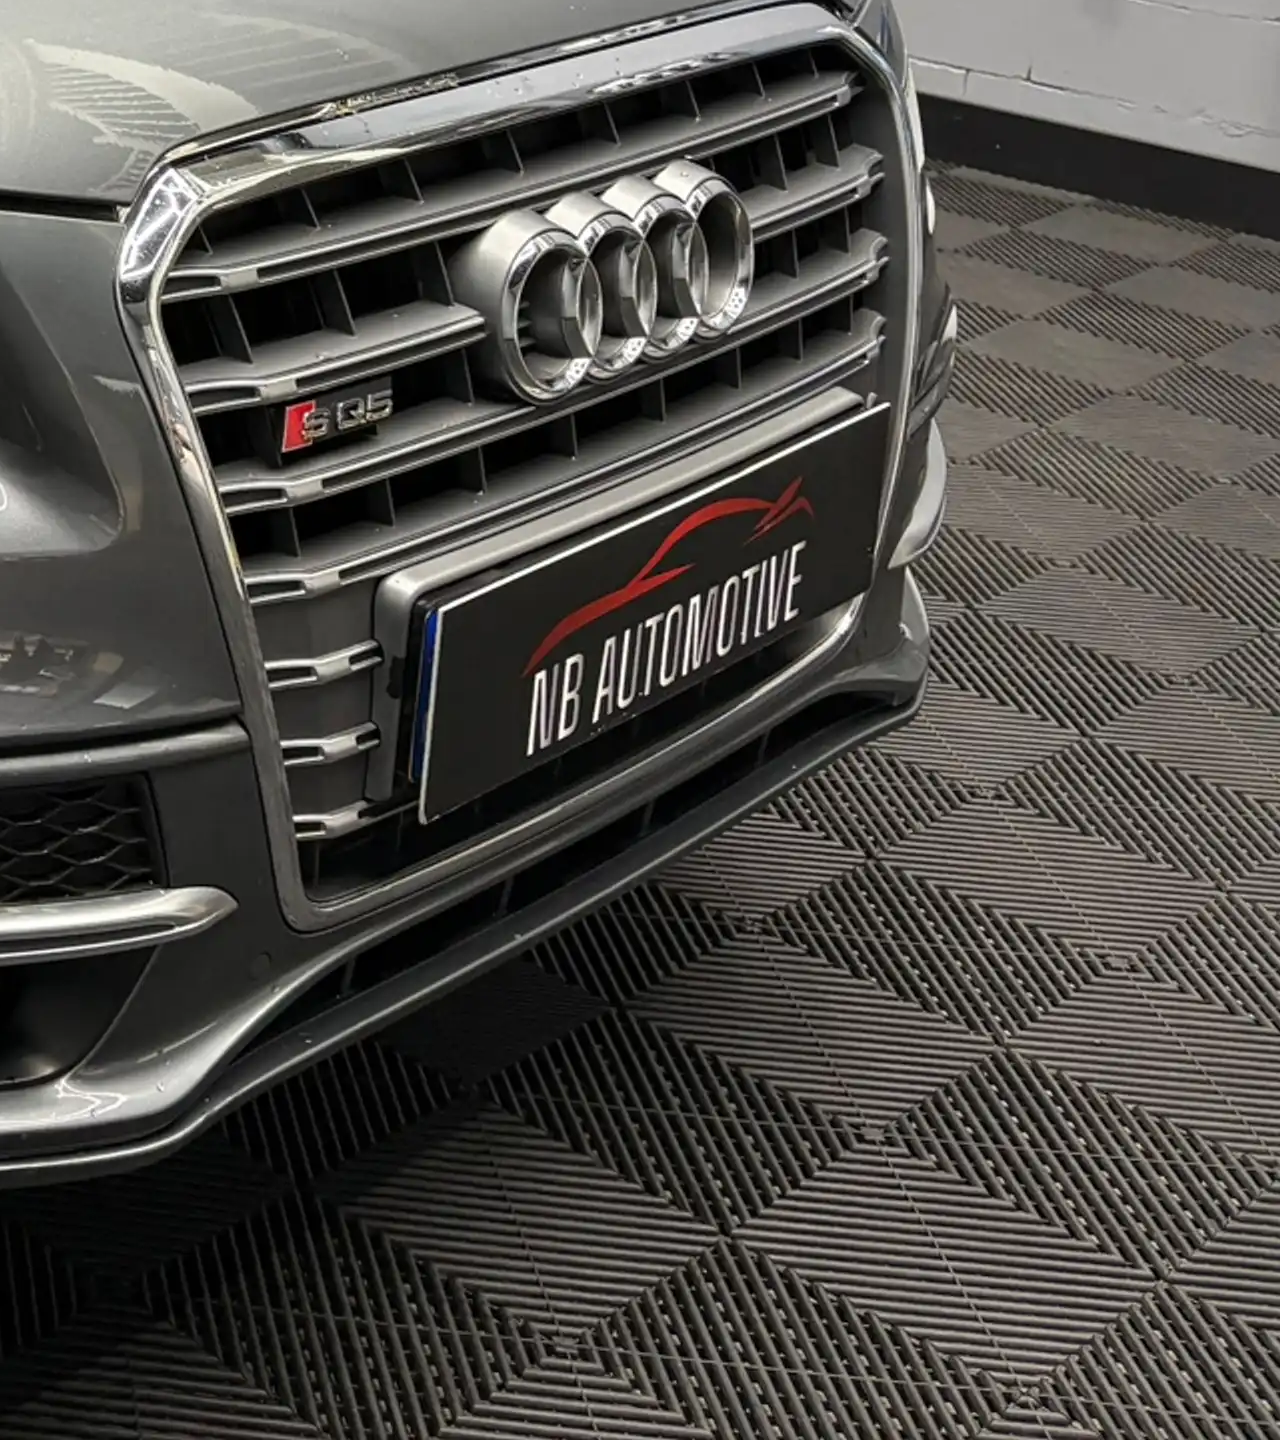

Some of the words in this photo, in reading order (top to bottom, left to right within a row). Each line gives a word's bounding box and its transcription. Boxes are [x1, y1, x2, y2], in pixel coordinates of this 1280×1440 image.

[301, 388, 394, 442] SQ5
[526, 652, 584, 757] NB
[592, 540, 807, 724] AUTOMOTIVE
